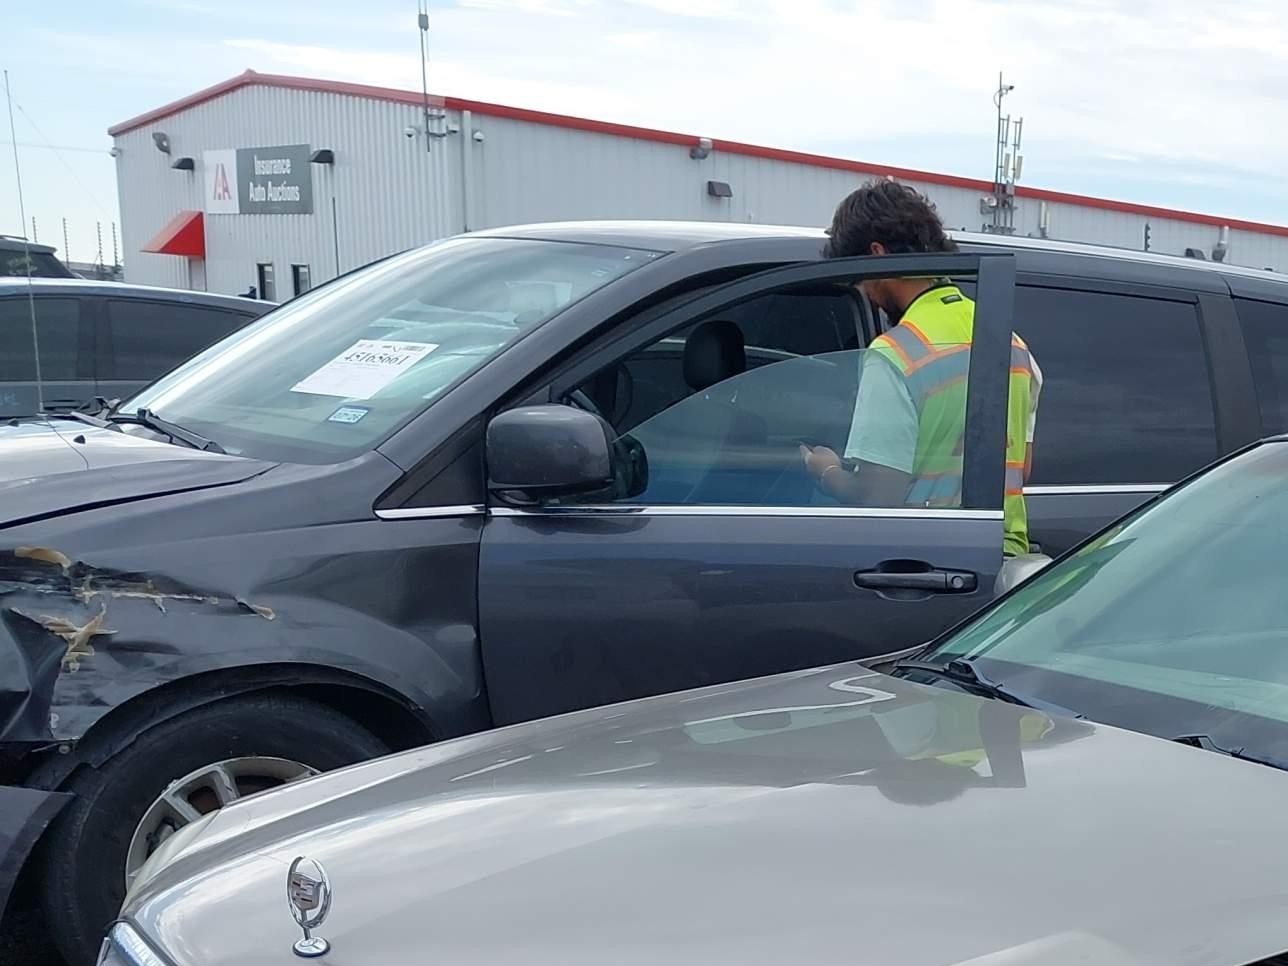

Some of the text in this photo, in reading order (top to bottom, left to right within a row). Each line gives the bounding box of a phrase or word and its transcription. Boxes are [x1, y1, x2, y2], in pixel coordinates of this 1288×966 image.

[253, 153, 291, 175] Insurance
[248, 180, 300, 202] Auto Auctions
